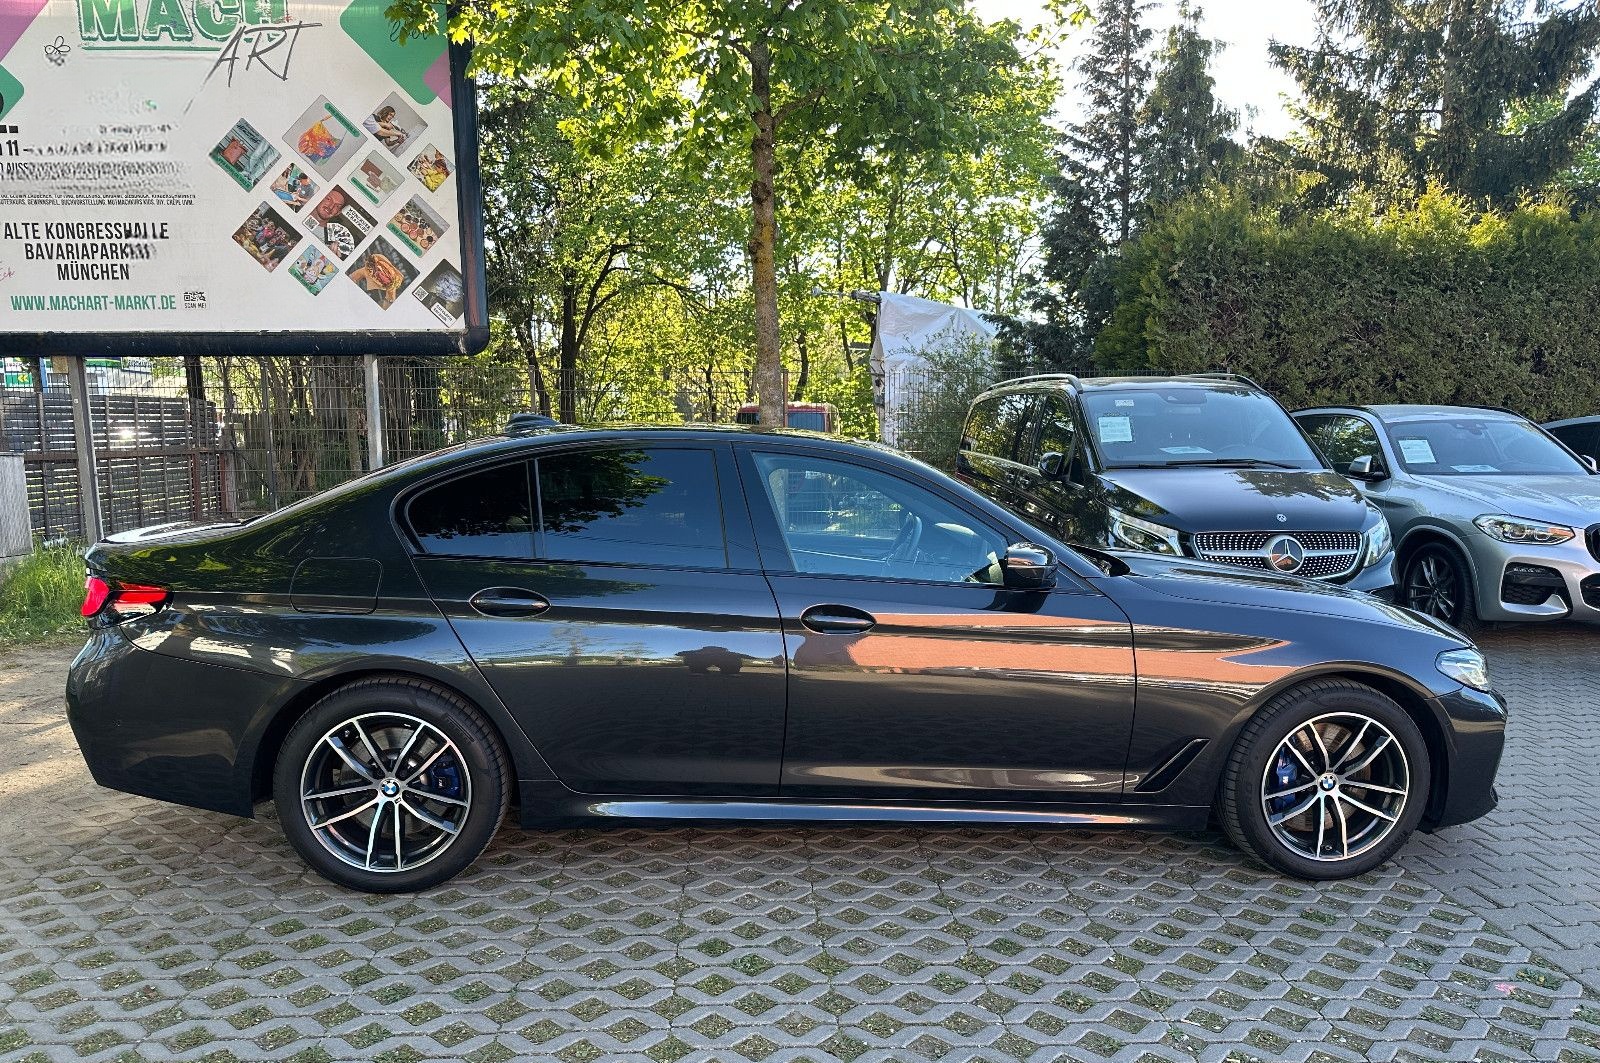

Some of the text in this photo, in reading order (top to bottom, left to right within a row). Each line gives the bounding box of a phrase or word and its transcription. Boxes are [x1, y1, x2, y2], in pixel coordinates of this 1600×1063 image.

[203, 21, 323, 87] ART
[4, 222, 40, 240] ALTE
[57, 261, 130, 281] MÜNCHEN
[11, 295, 177, 311] WWW.MACHART-MARKT.DE
